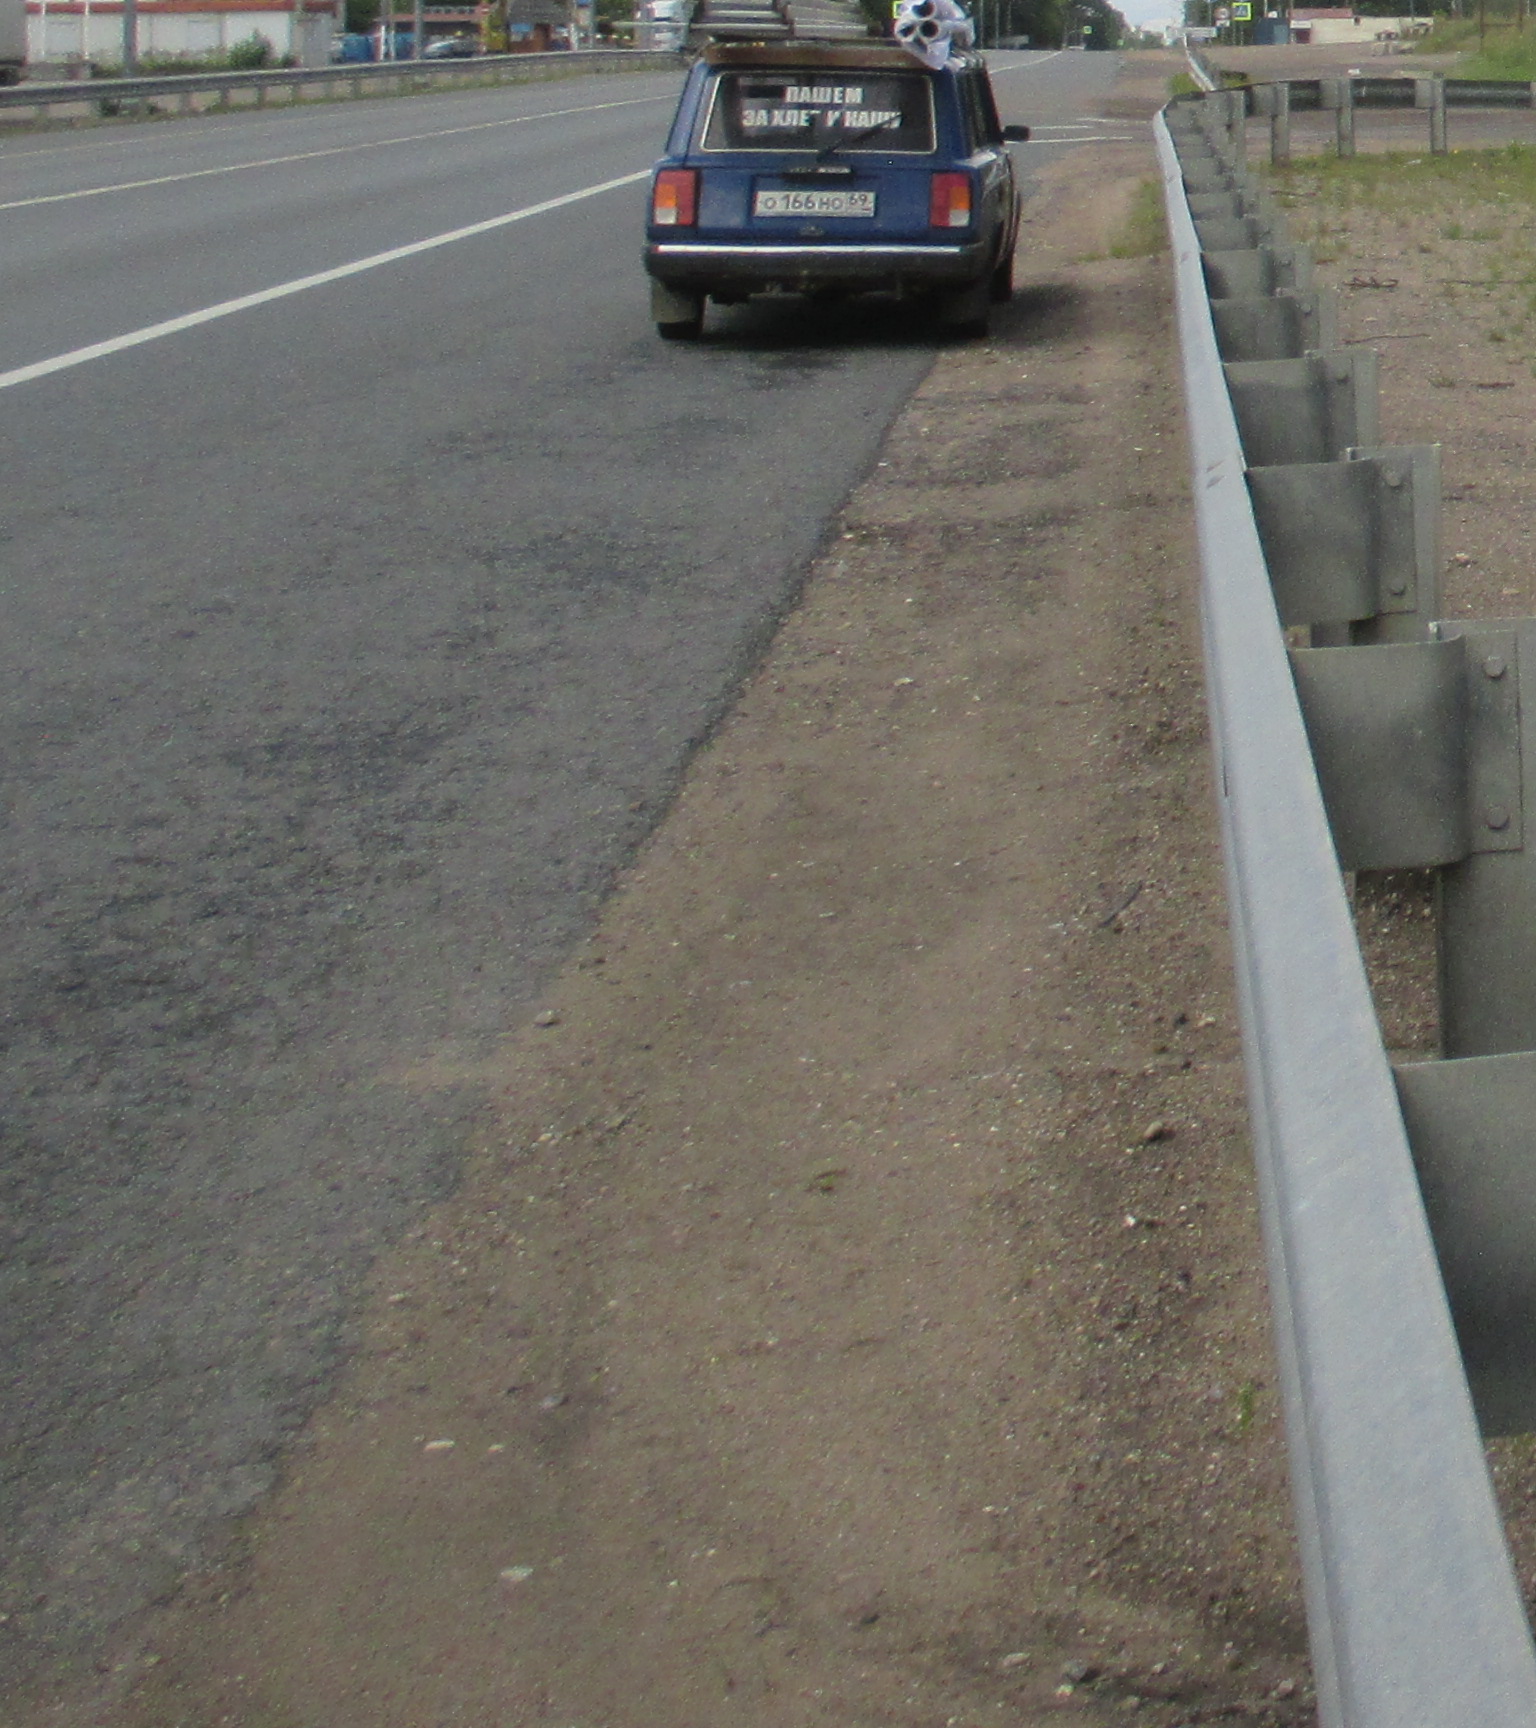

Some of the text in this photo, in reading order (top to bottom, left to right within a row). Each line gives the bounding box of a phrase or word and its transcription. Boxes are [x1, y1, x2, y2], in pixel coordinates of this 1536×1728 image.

[785, 86, 863, 103] ПАШЕМ
[742, 110, 768, 126] ЗА
[771, 110, 821, 126] ХЛЕ
